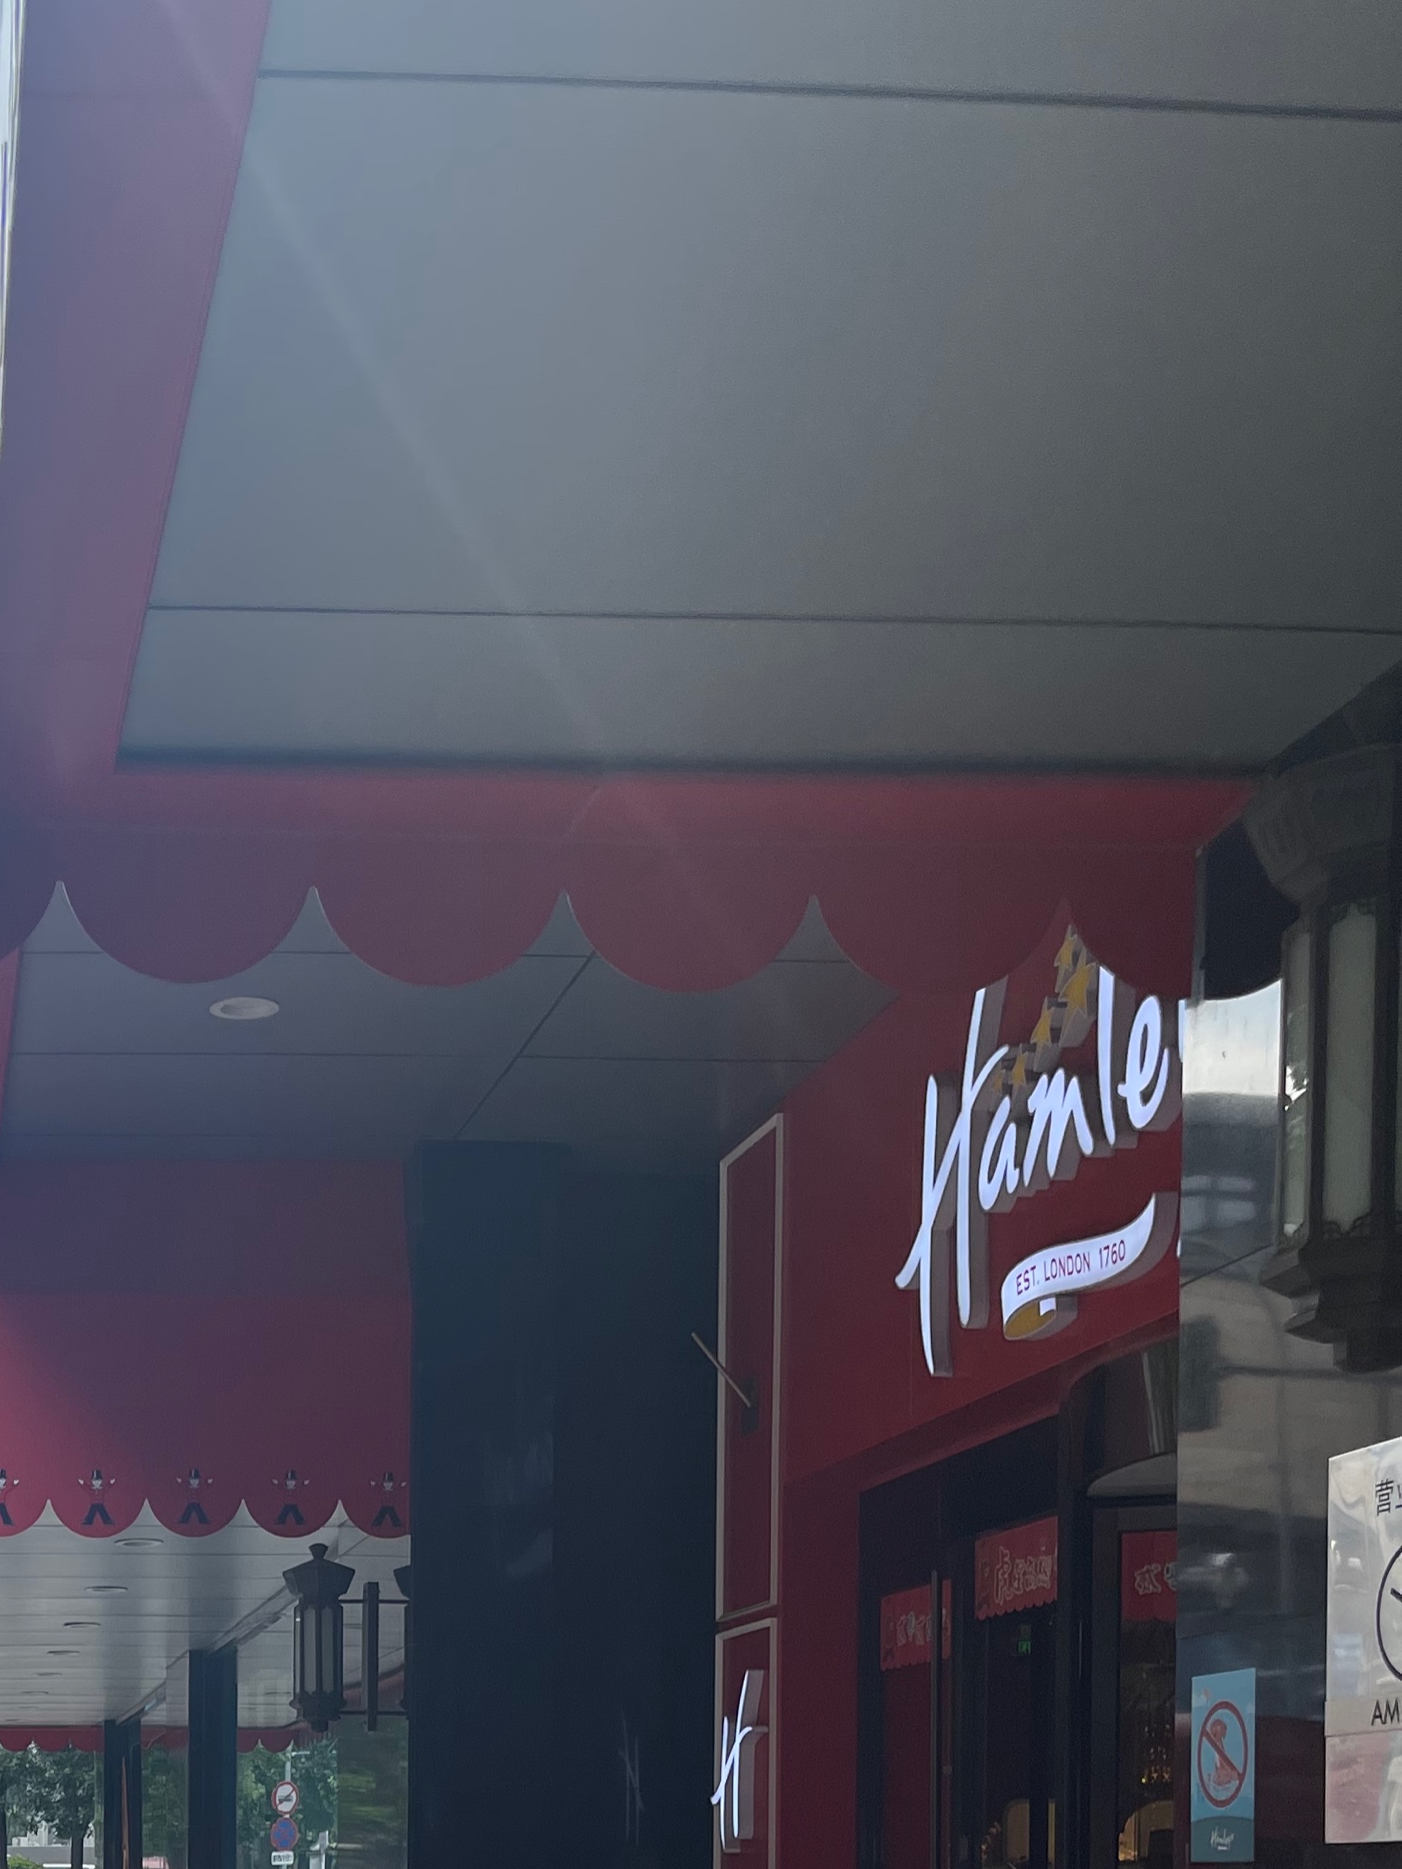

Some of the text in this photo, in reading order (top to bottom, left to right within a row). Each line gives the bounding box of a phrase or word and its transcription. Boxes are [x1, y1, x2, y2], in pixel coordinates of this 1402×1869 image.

[895, 965, 1184, 1376] Hamle
[1015, 1239, 1126, 1297] EST. LONDON 1760
